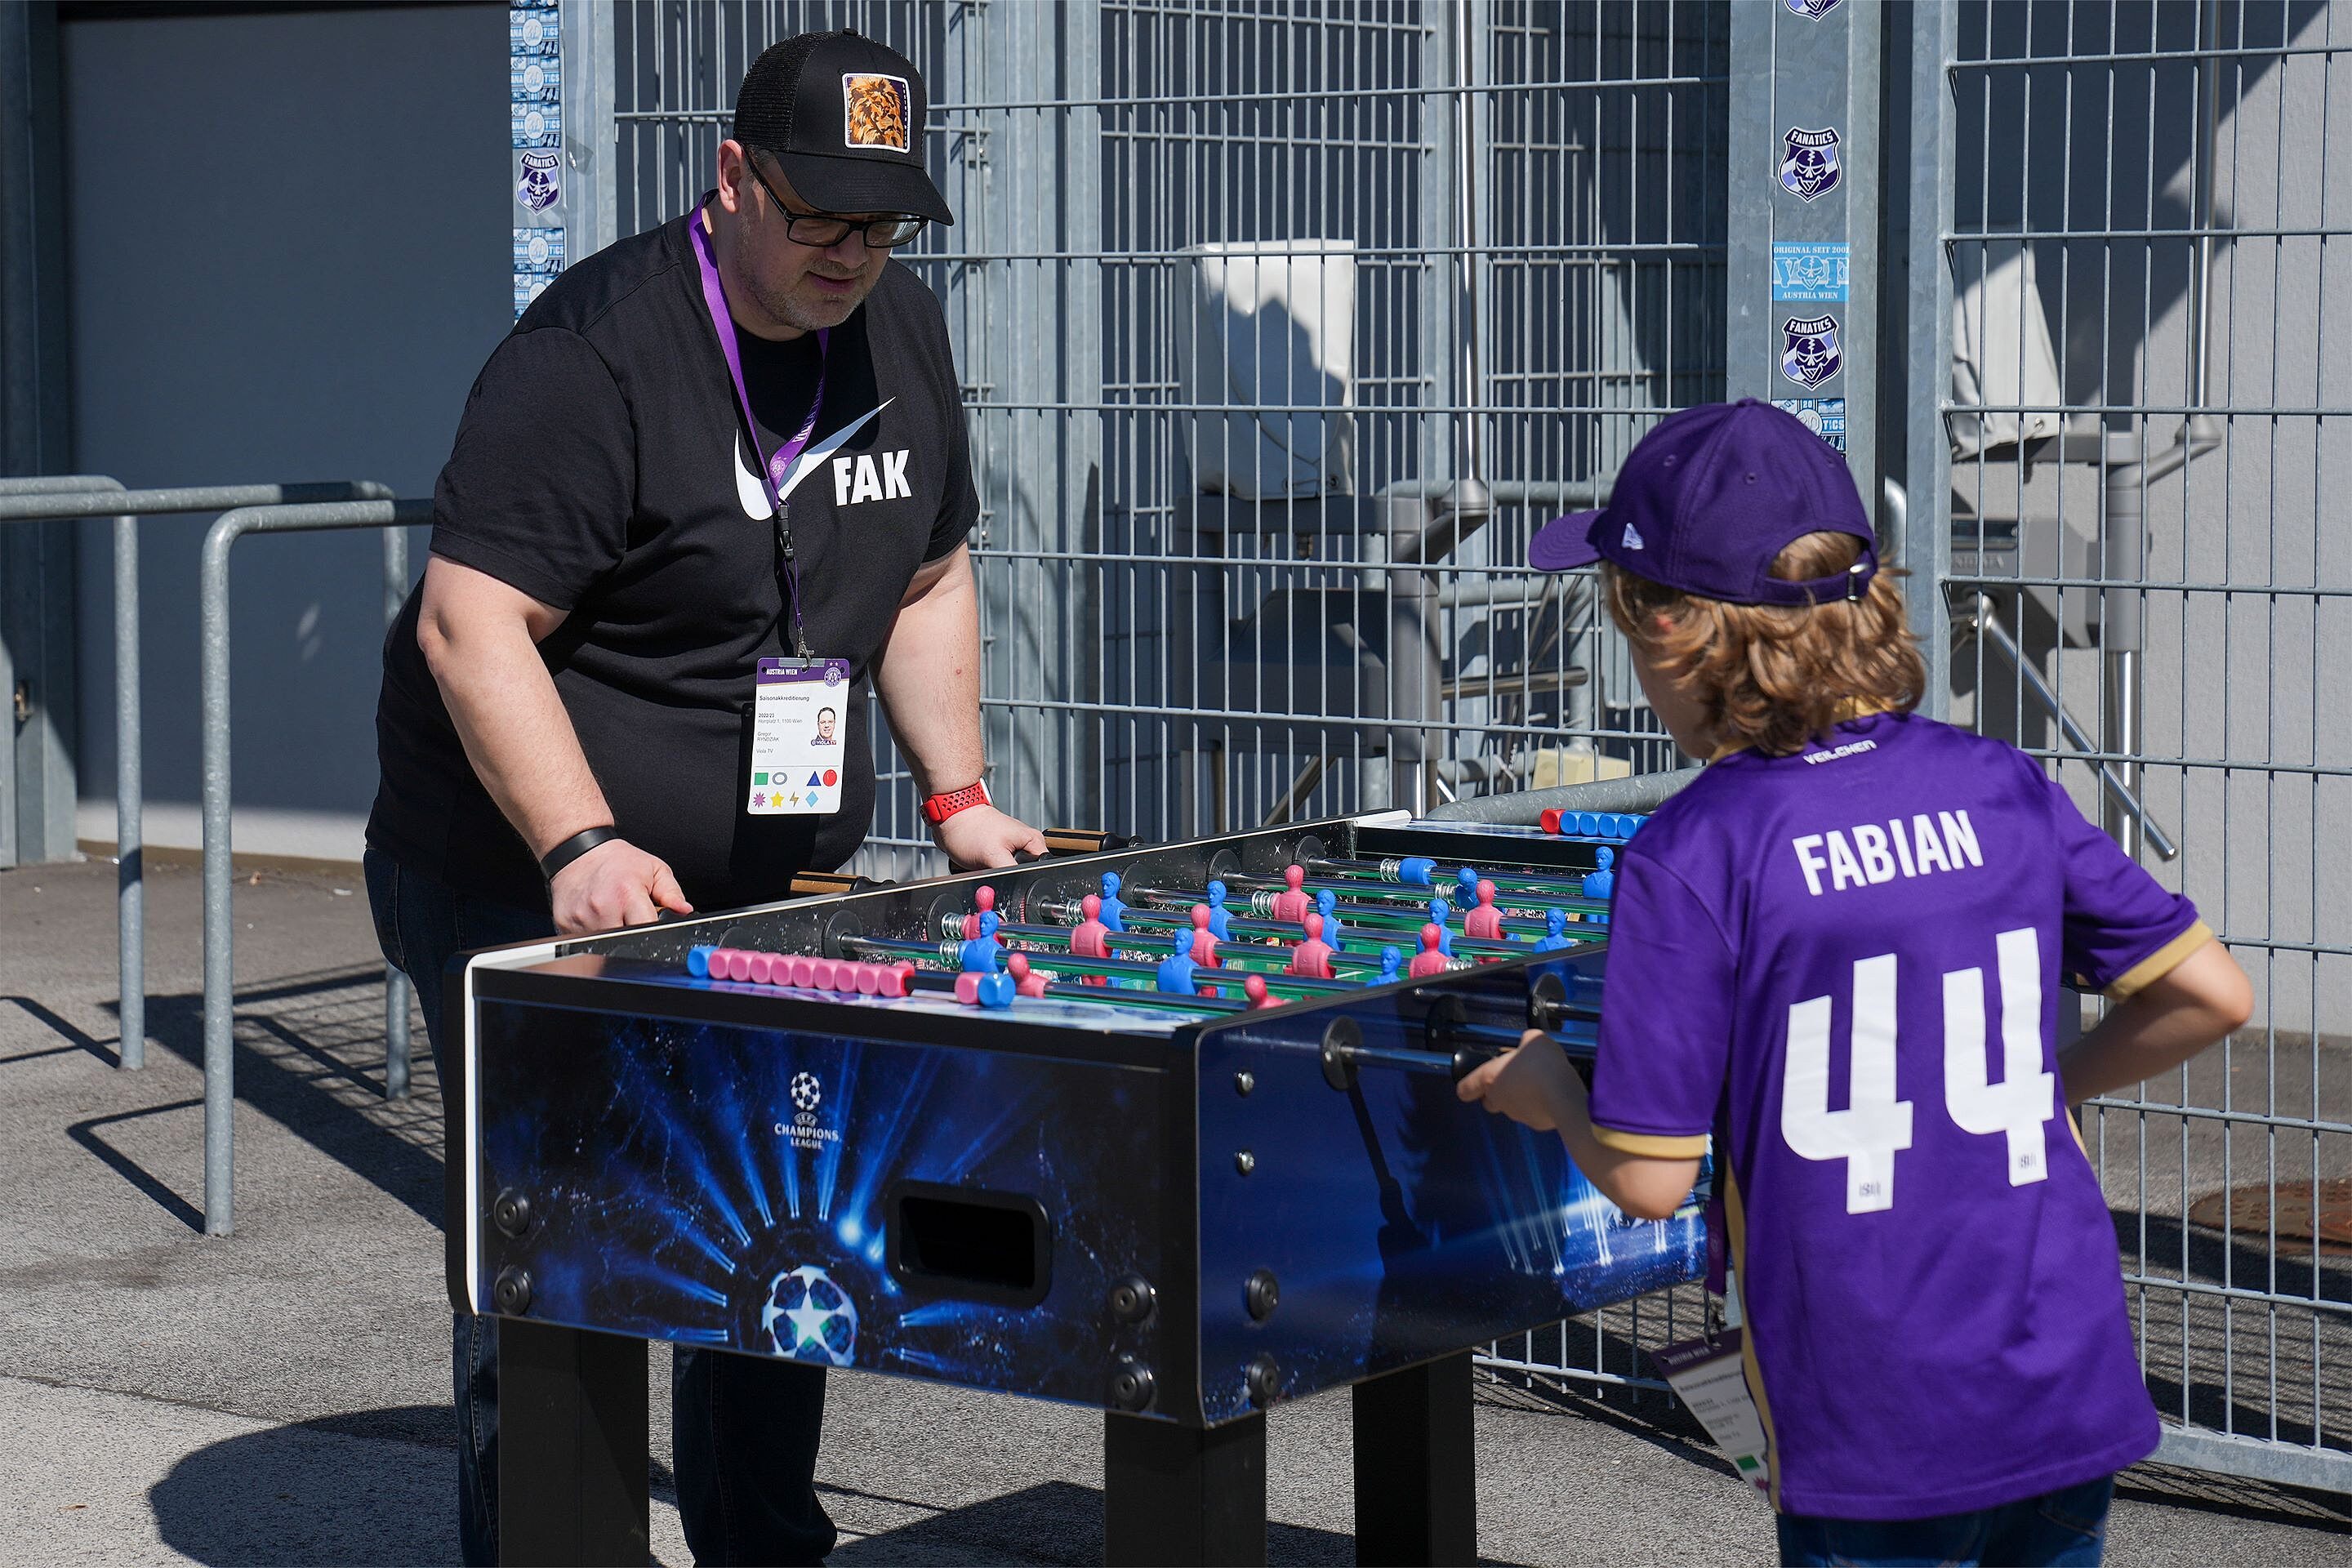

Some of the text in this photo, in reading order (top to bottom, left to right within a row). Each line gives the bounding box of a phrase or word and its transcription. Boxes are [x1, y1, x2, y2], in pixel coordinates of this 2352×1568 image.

[1791, 131, 1833, 145] FANATICS
[524, 155, 555, 168] FANATICS
[1818, 292, 1838, 300] WIEN
[1788, 317, 1832, 334] FANATICS
[1823, 418, 1844, 430] TICS
[832, 448, 912, 507] FAK
[1793, 809, 1984, 897] FABIAN
[1781, 927, 2055, 1214] 44
[795, 1113, 817, 1125] UEFA
[773, 1122, 840, 1143] CHAMPIONS
[790, 1138, 823, 1150] LEAGUE
